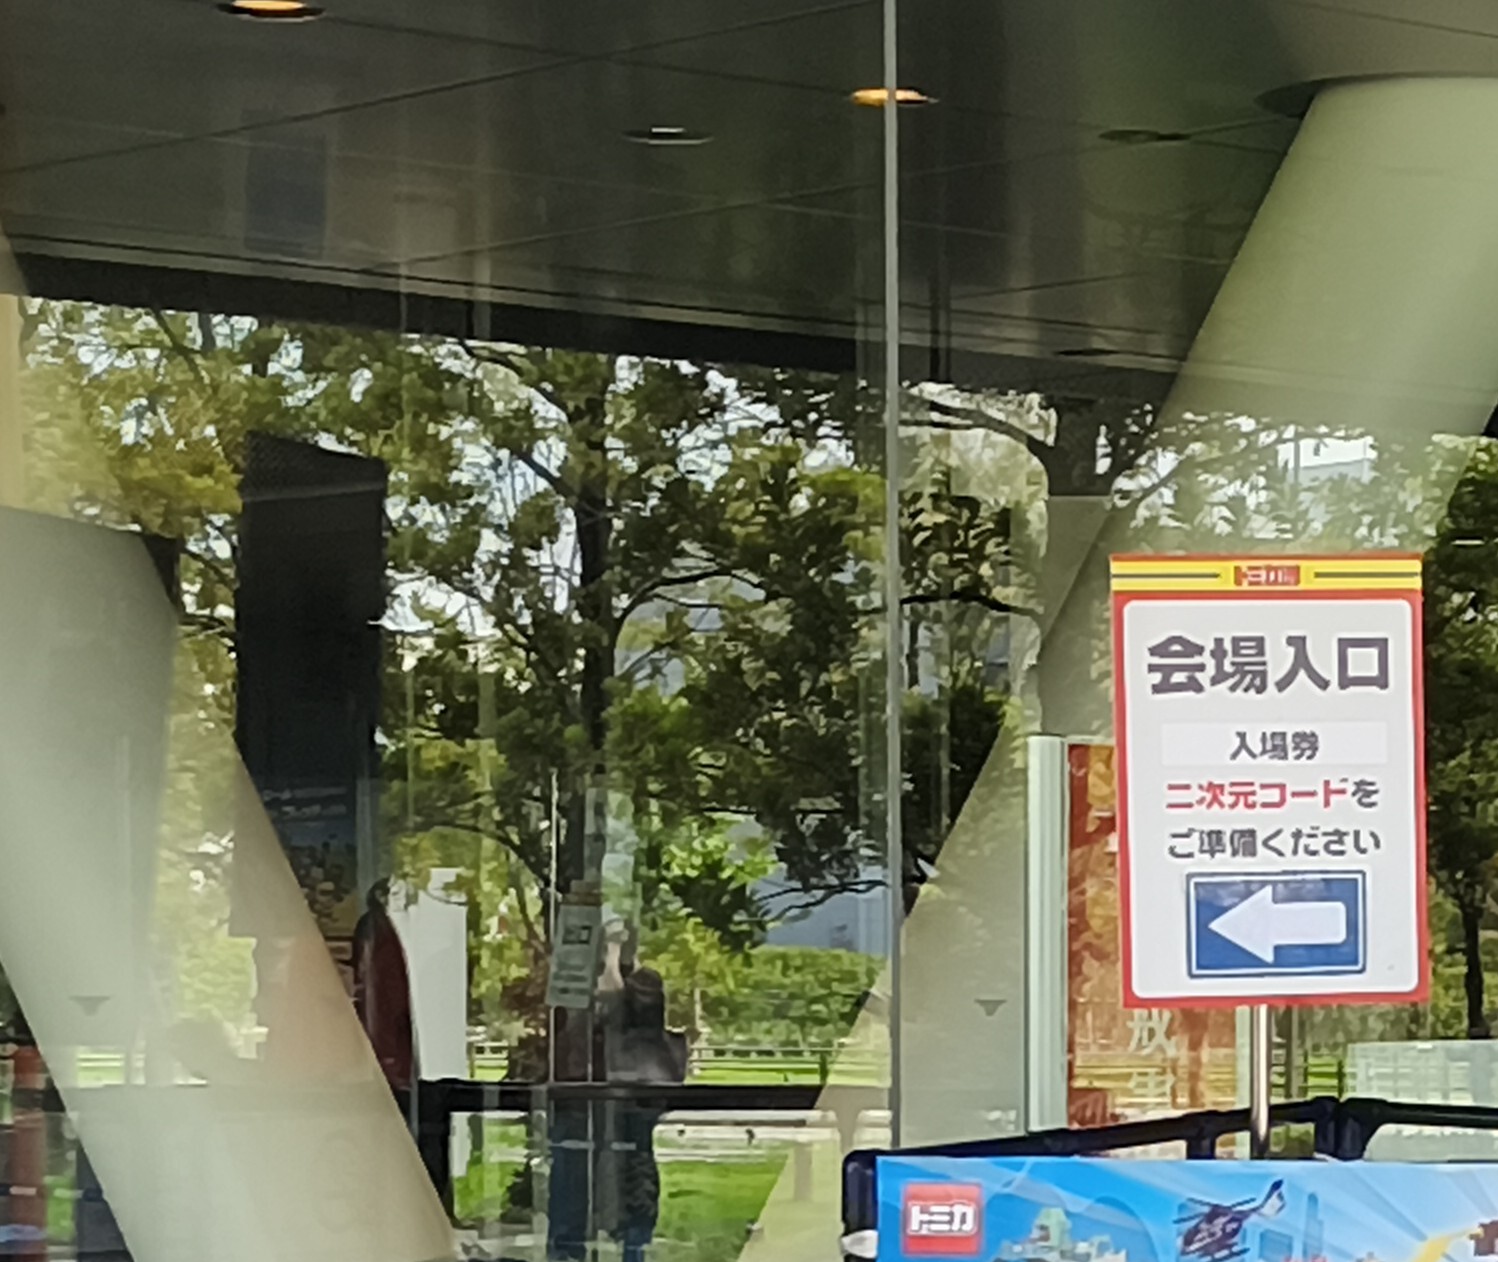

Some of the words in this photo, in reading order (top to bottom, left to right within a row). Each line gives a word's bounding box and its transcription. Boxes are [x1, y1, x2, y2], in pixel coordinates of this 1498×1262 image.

[1148, 635, 1389, 694] 会場入口
[1230, 731, 1320, 760] 入場券
[1166, 778, 1380, 809] 二次元コードを
[1168, 828, 1381, 860] ご準備ください
[910, 1202, 976, 1234] トミカ
